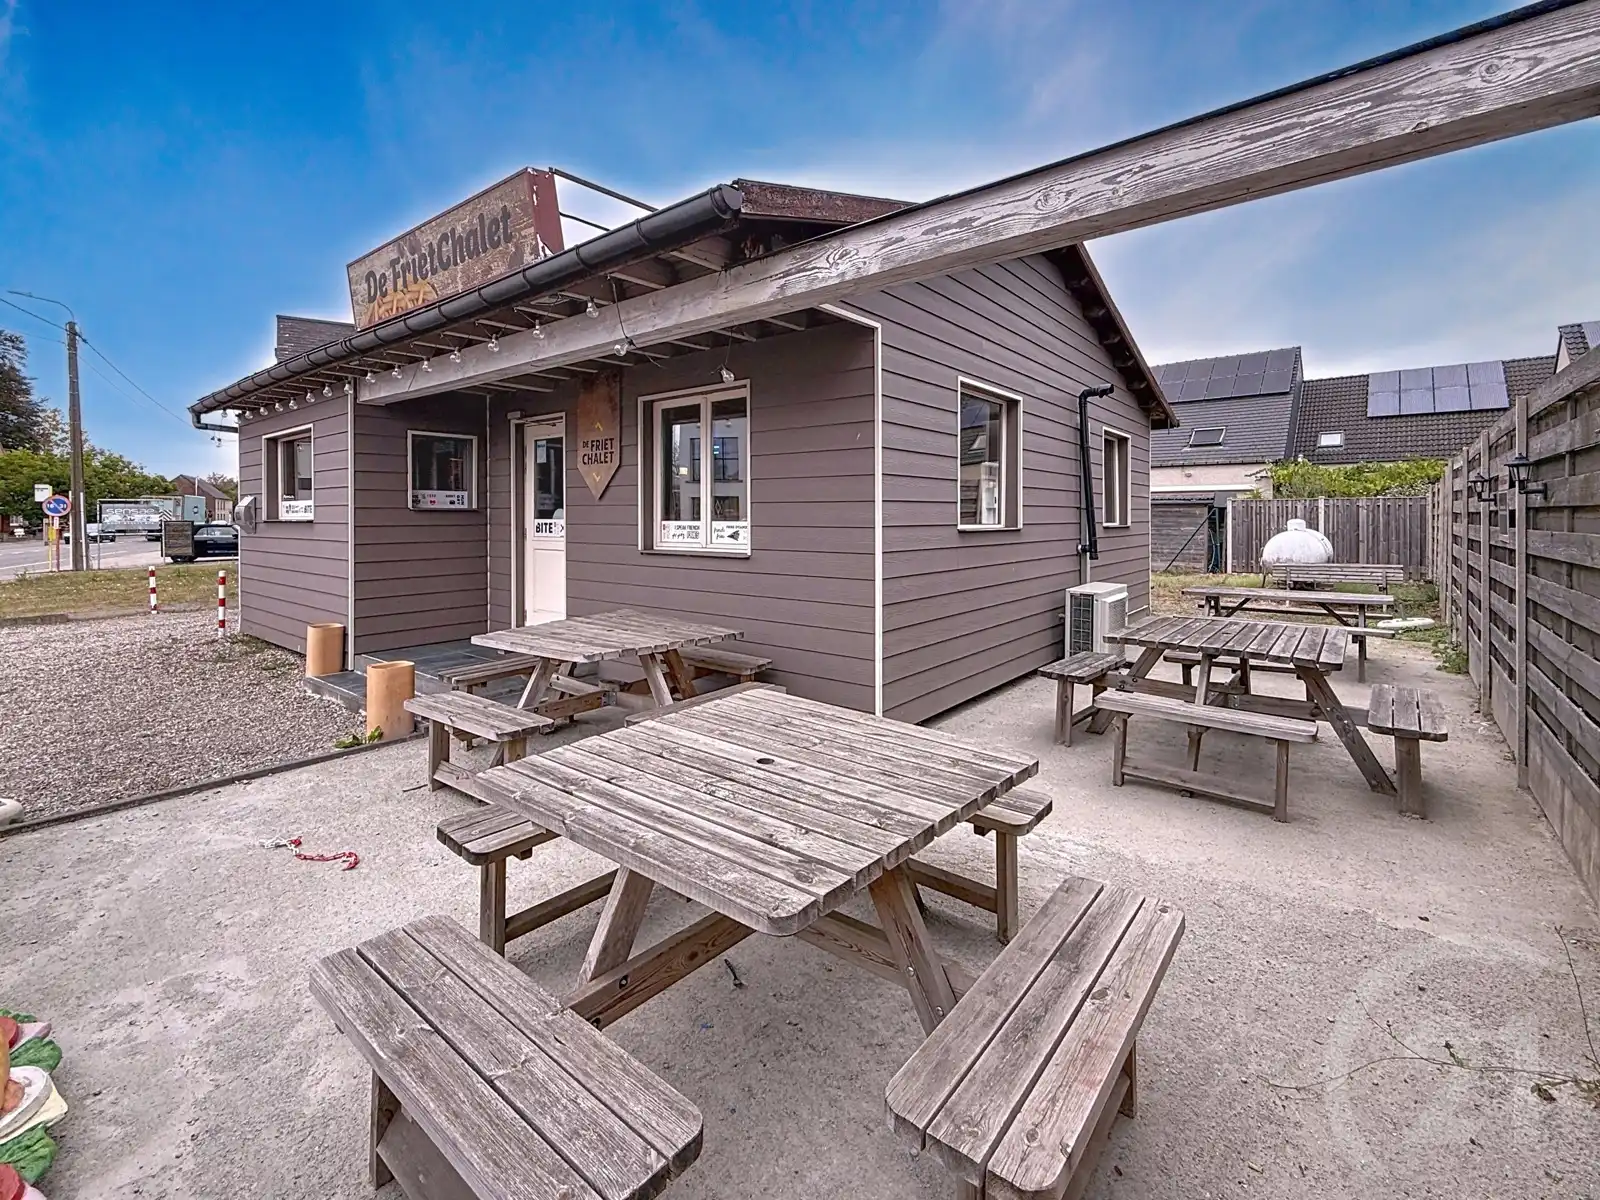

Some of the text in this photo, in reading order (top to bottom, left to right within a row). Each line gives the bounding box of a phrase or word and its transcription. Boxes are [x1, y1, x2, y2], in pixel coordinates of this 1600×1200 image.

[365, 270, 388, 304] De
[583, 438, 615, 452] DE FRIET
[582, 450, 615, 466] CHALET
[535, 522, 553, 534] BITE
